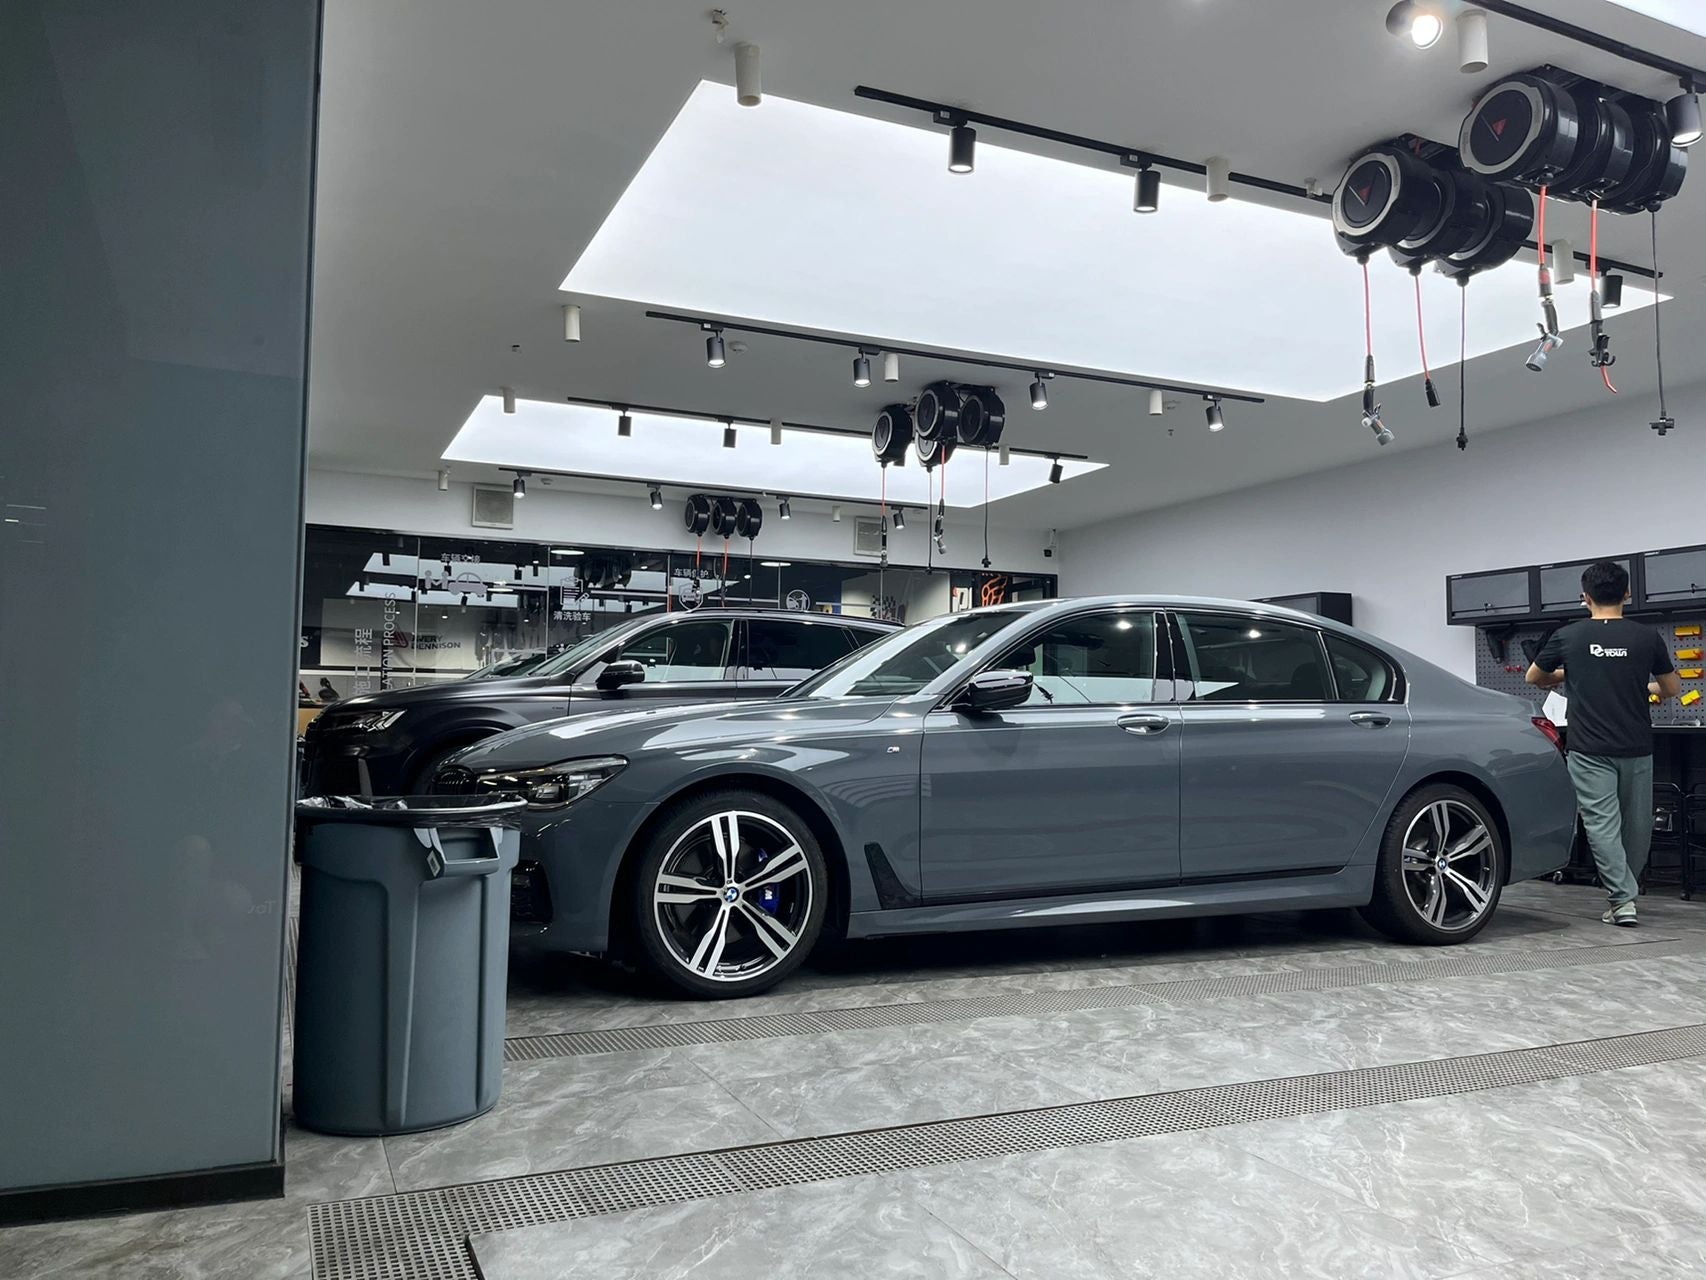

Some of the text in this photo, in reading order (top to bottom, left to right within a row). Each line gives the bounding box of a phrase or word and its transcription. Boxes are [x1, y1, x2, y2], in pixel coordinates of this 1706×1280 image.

[383, 592, 397, 647] PROCESS
[553, 611, 591, 621] 清洗验车
[411, 642, 461, 650] DENNISON
